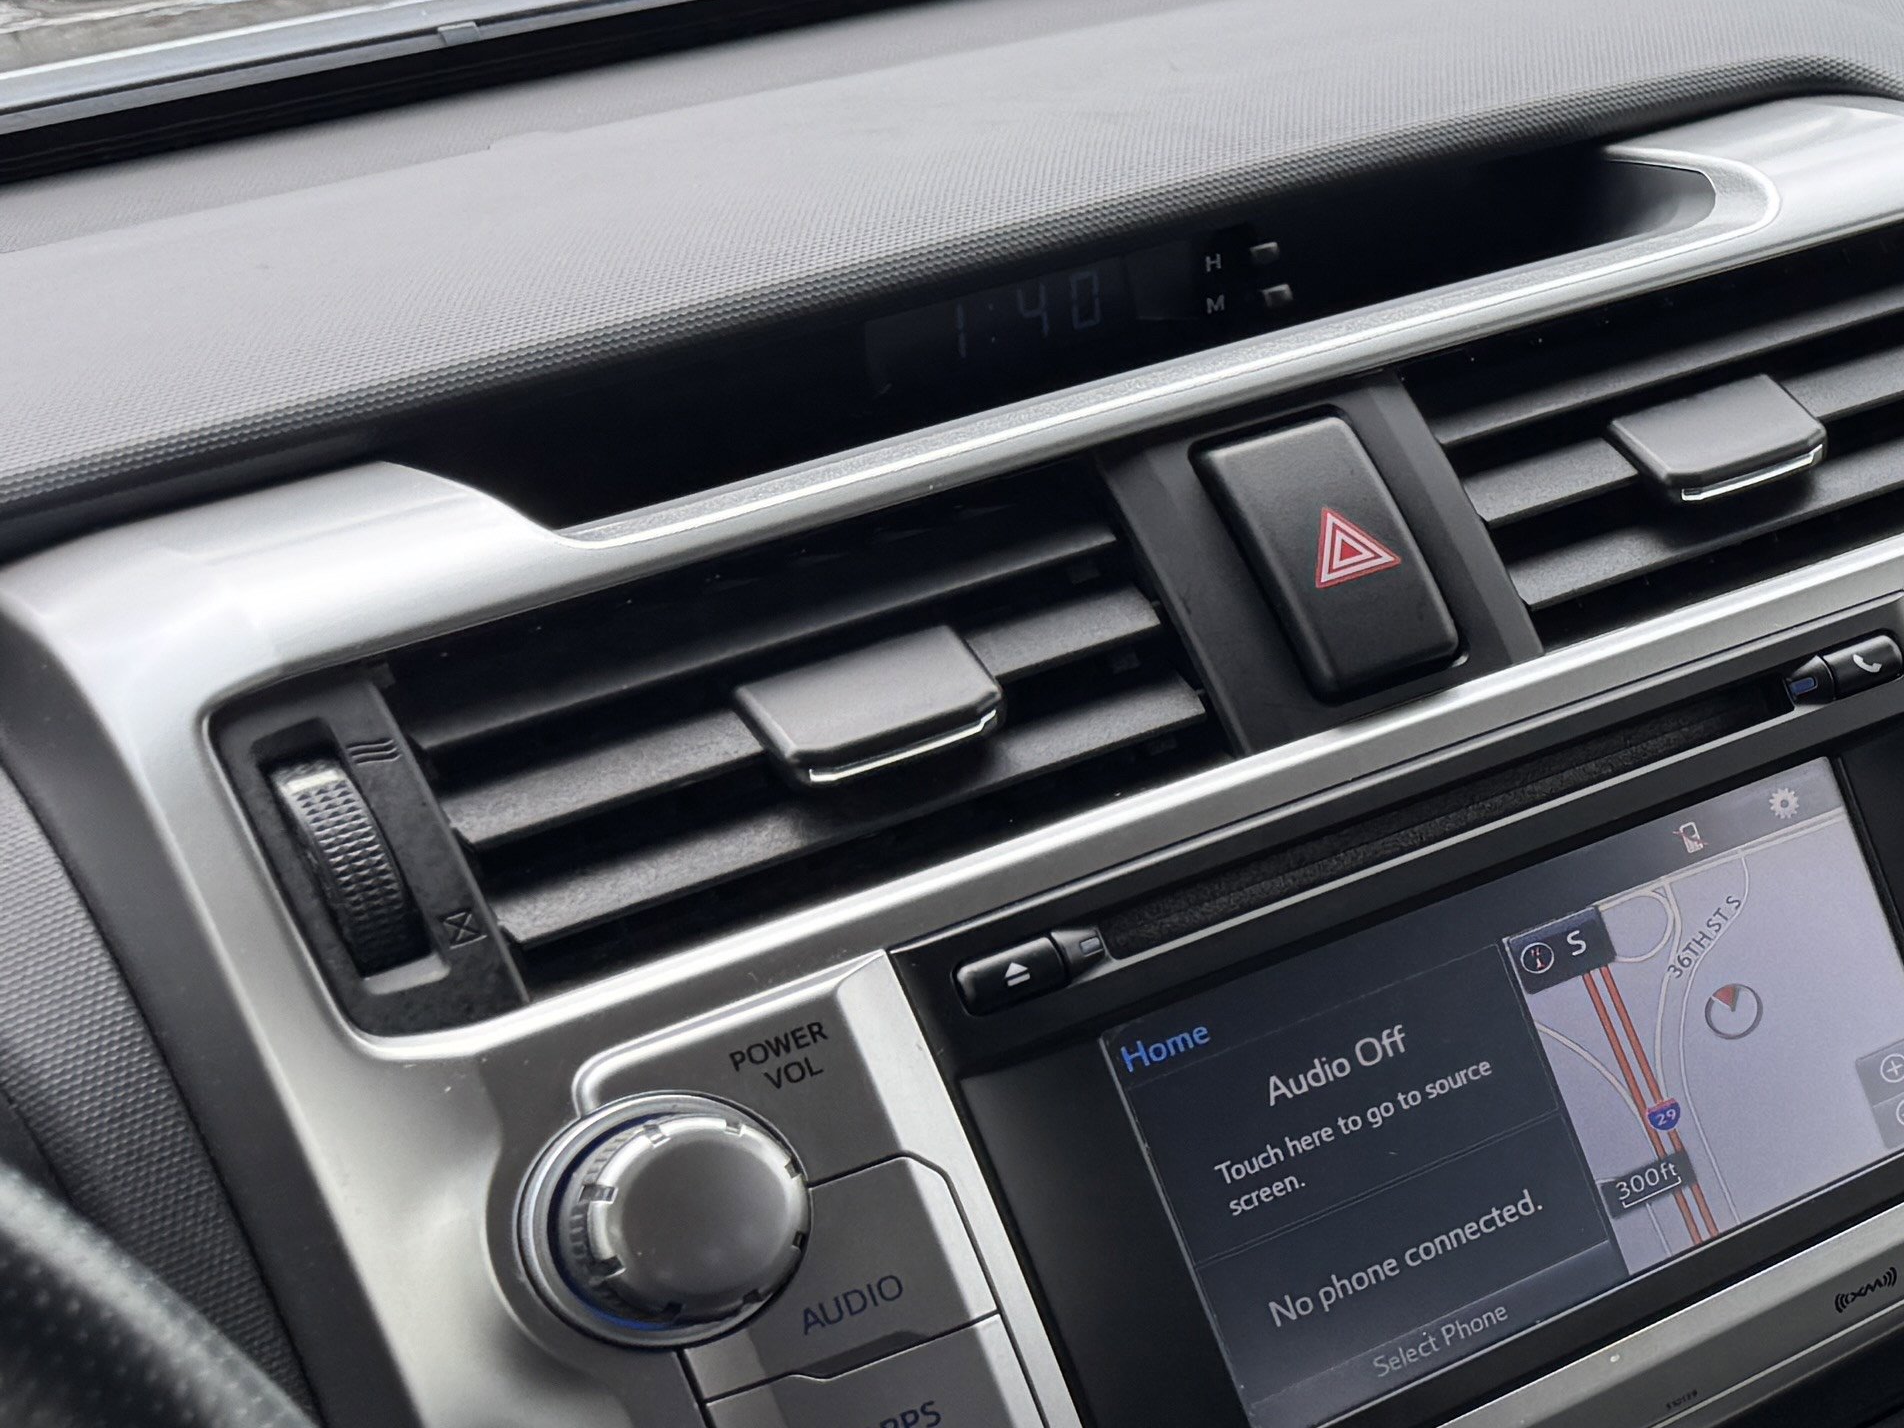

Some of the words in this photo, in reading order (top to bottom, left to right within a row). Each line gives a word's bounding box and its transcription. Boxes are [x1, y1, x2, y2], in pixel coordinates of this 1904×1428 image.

[1204, 251, 1223, 273] H
[1205, 293, 1226, 315] M
[1566, 929, 1587, 957] S
[1667, 930, 1710, 980] 36TH
[1706, 907, 1732, 937] ST
[1726, 895, 1742, 911] S
[728, 1021, 829, 1072] POWER
[1120, 1023, 1212, 1072] Home
[1266, 1053, 1352, 1107] Audio
[1354, 1024, 1407, 1068] Off
[763, 1054, 824, 1091] VOL
[1214, 1139, 1285, 1185] Touch
[1284, 1123, 1336, 1158] here
[1337, 1108, 1363, 1135] to
[1366, 1098, 1396, 1128] go
[1397, 1084, 1422, 1110] to
[1425, 1058, 1493, 1099] source
[1655, 1108, 1679, 1126] 29
[1228, 1173, 1306, 1217] screen.
[1614, 1160, 1679, 1202] 300ft
[1268, 1293, 1315, 1329] No
[1317, 1253, 1400, 1312] phone
[1403, 1188, 1543, 1269] connected.
[800, 1273, 904, 1337] AUDIO
[1372, 1331, 1438, 1378] Select
[1440, 1304, 1508, 1347] Phone
